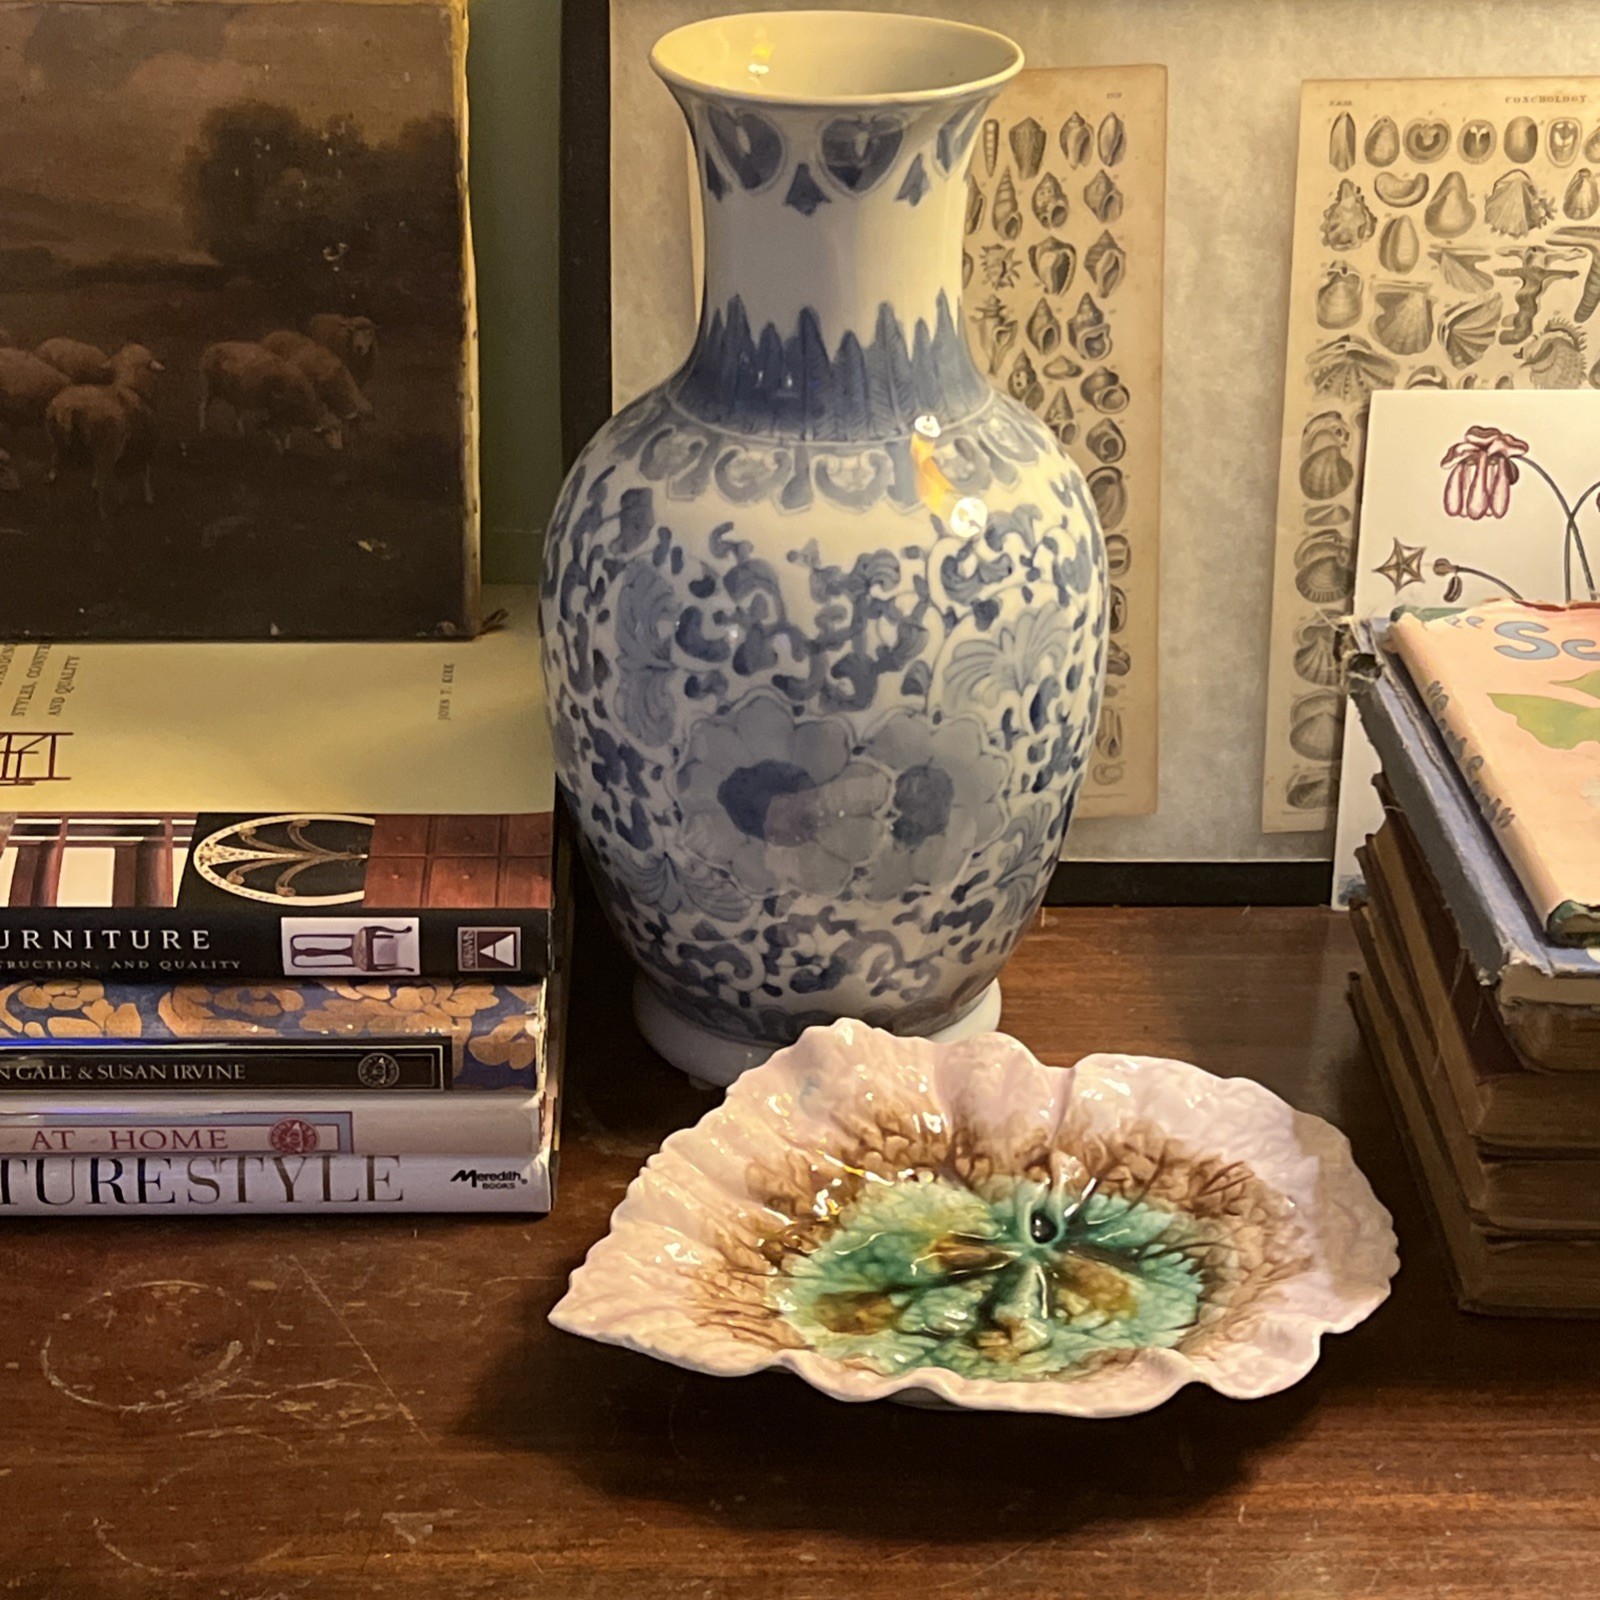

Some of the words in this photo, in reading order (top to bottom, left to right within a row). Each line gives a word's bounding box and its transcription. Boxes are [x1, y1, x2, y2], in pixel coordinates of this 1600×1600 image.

[111, 960, 149, 969] AND
[159, 960, 241, 971] QUALITY
[16, 1065, 71, 1080] GALE
[78, 1066, 93, 1080] &
[97, 1064, 167, 1080] SUSAN
[173, 1063, 246, 1080] IRVINE
[31, 1130, 76, 1150] AT
[109, 1129, 229, 1150] HOME
